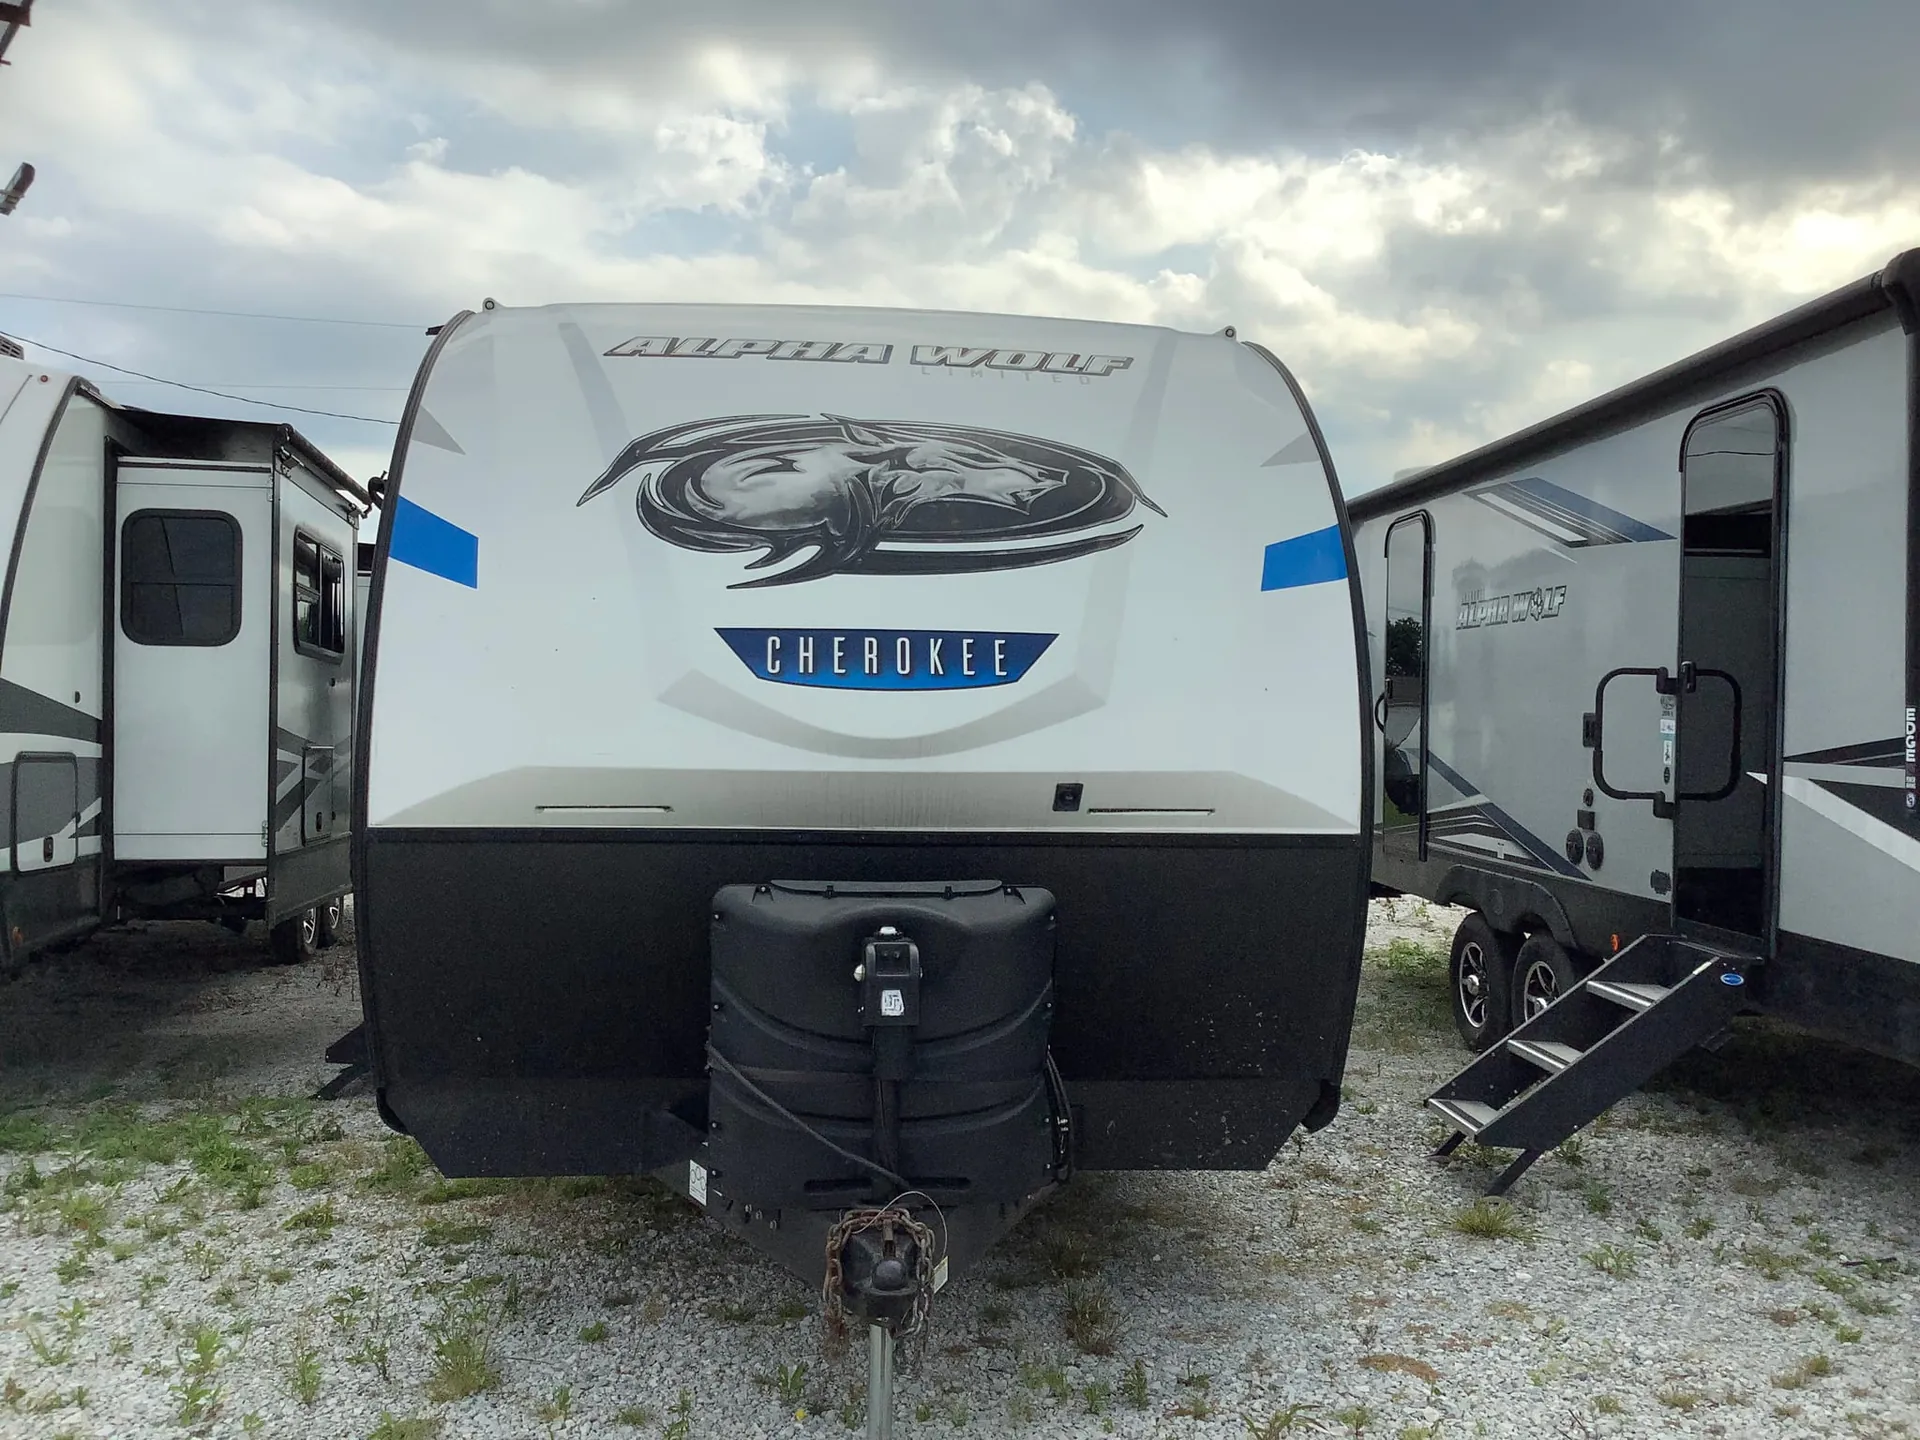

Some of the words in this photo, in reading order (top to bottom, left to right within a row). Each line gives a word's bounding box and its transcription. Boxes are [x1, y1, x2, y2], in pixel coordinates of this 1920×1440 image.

[602, 336, 894, 364] ALPHA
[910, 344, 1134, 376] WOLF
[921, 365, 1092, 386] LIMITED
[1456, 595, 1510, 630] ALPHA
[766, 636, 1008, 676] CHEROKEE
